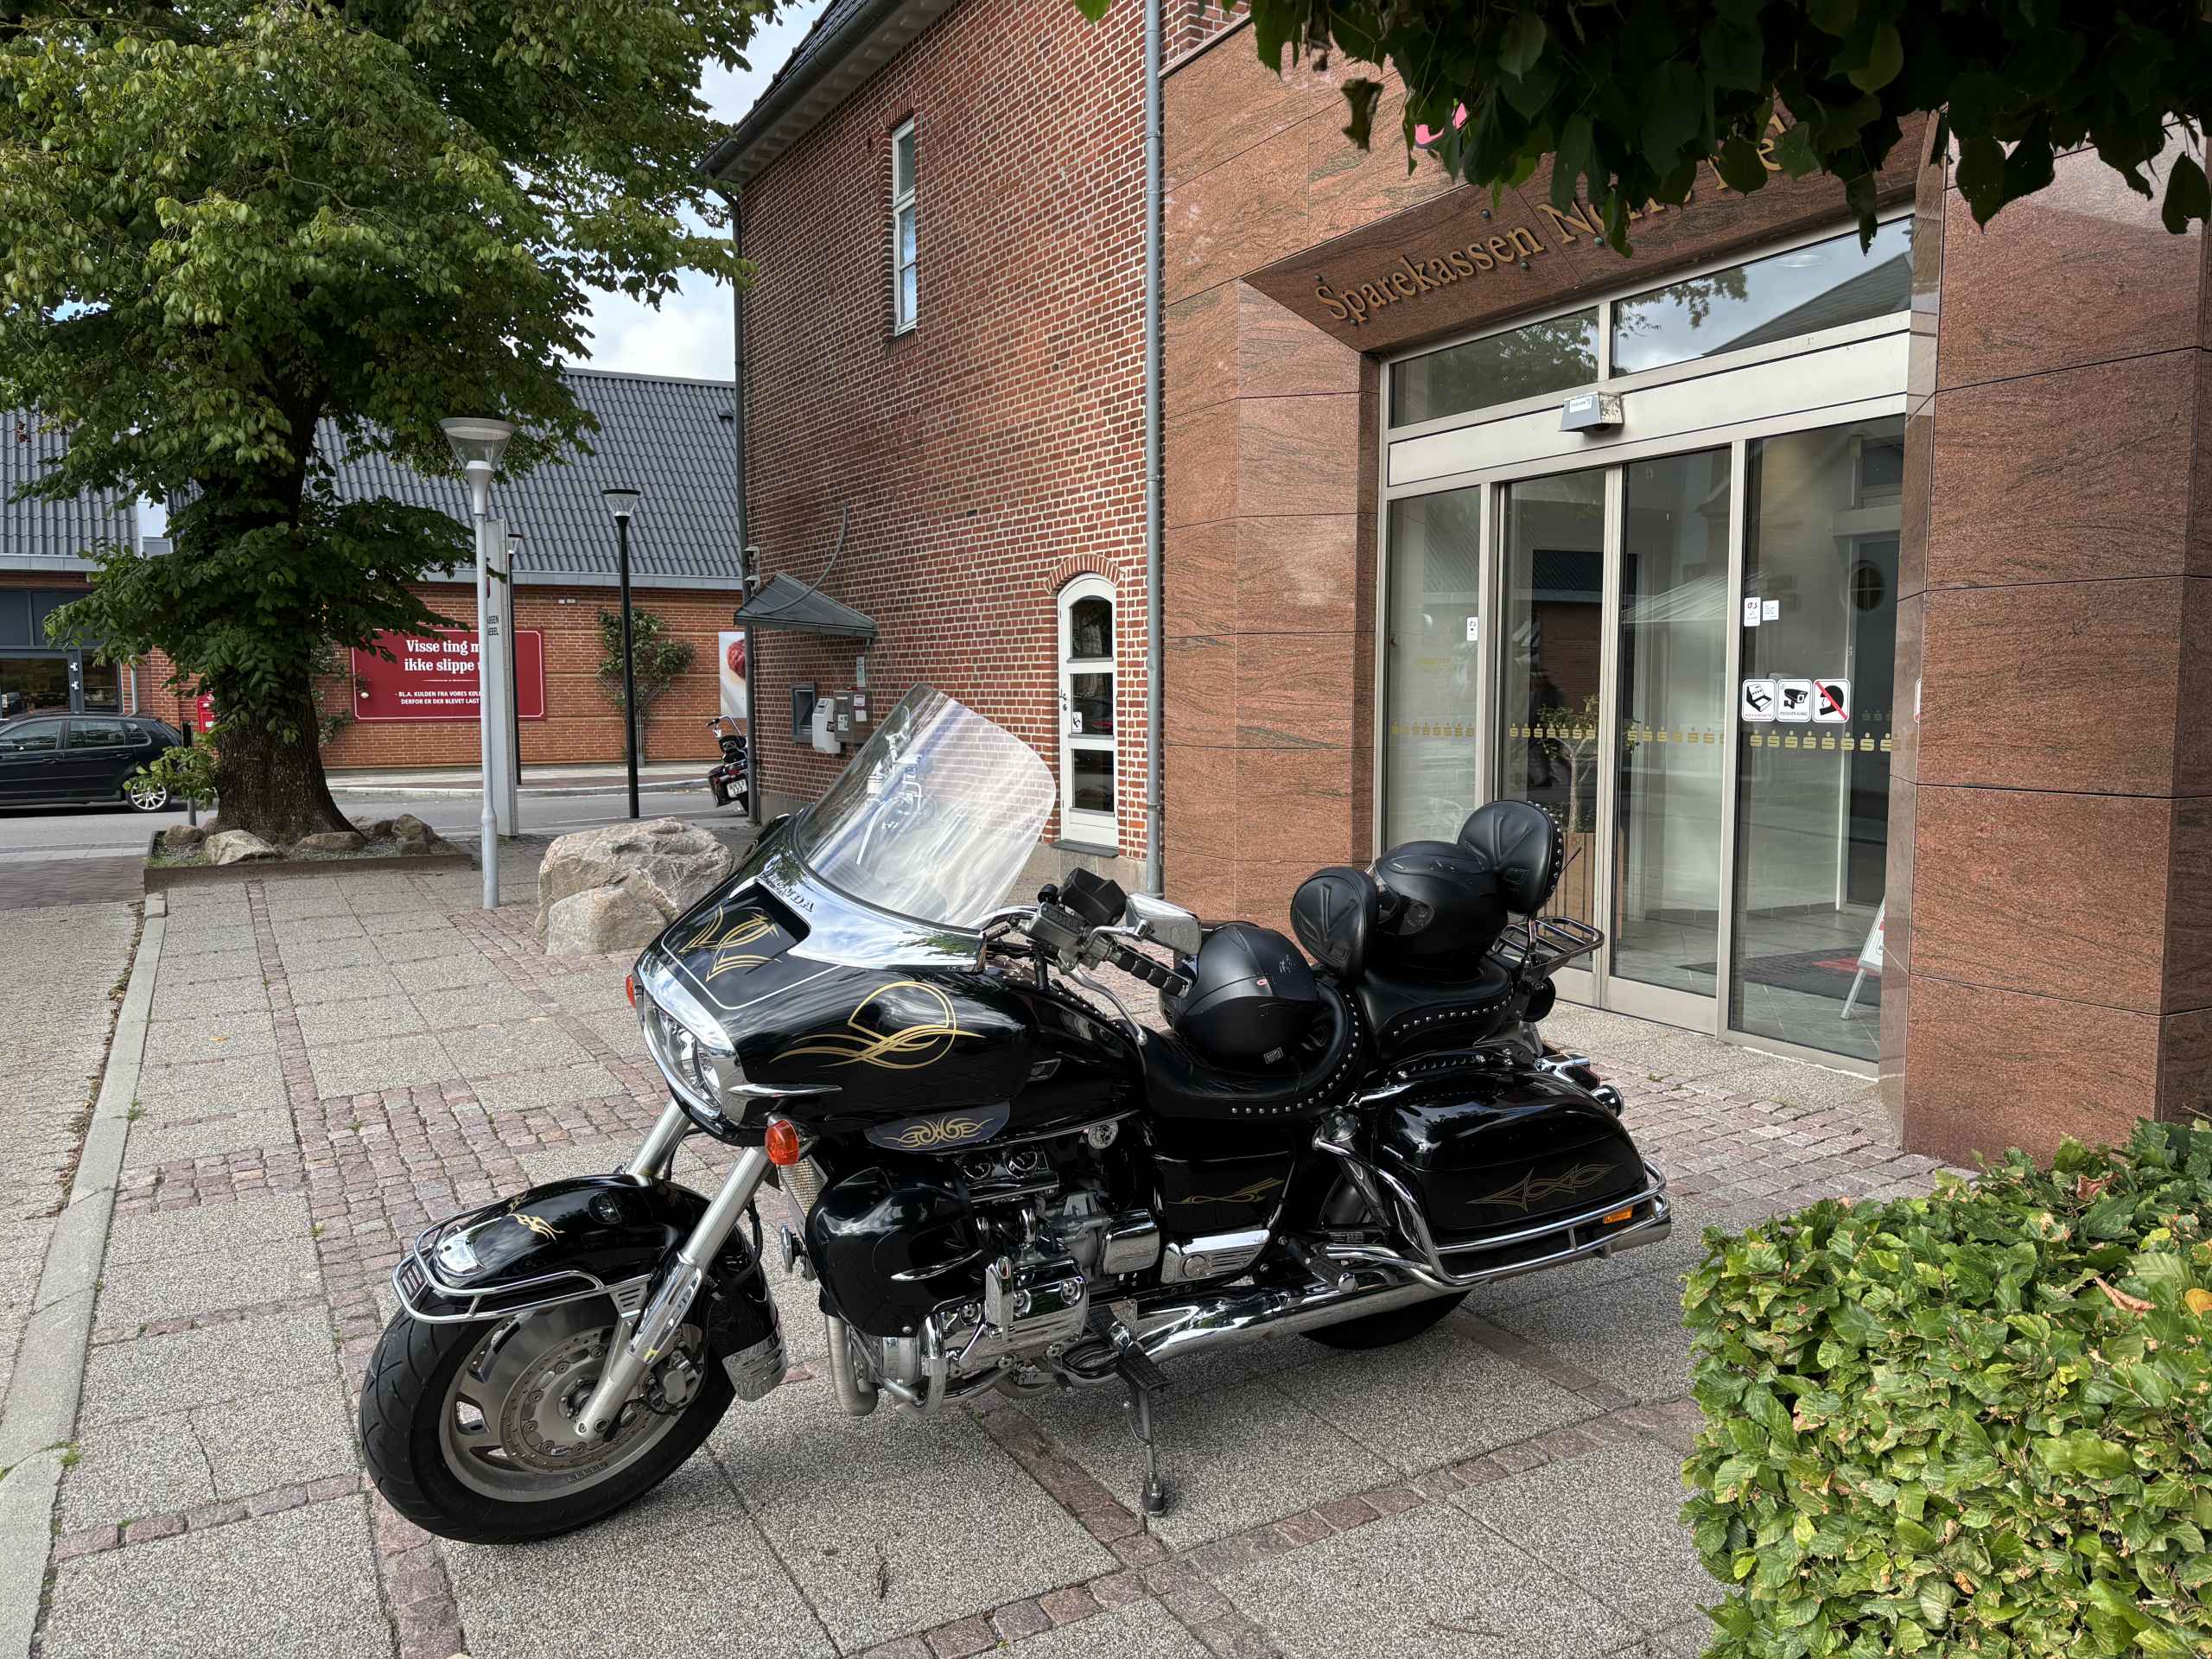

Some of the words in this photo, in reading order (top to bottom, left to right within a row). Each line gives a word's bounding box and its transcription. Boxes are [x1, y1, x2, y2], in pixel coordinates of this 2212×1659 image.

[1314, 226, 1546, 324] Sparekassen
[406, 639, 440, 652] Visse
[442, 639, 468, 656] ting
[404, 658, 434, 671] ikke
[435, 658, 474, 674] slippe
[764, 869, 815, 912] HONDA
